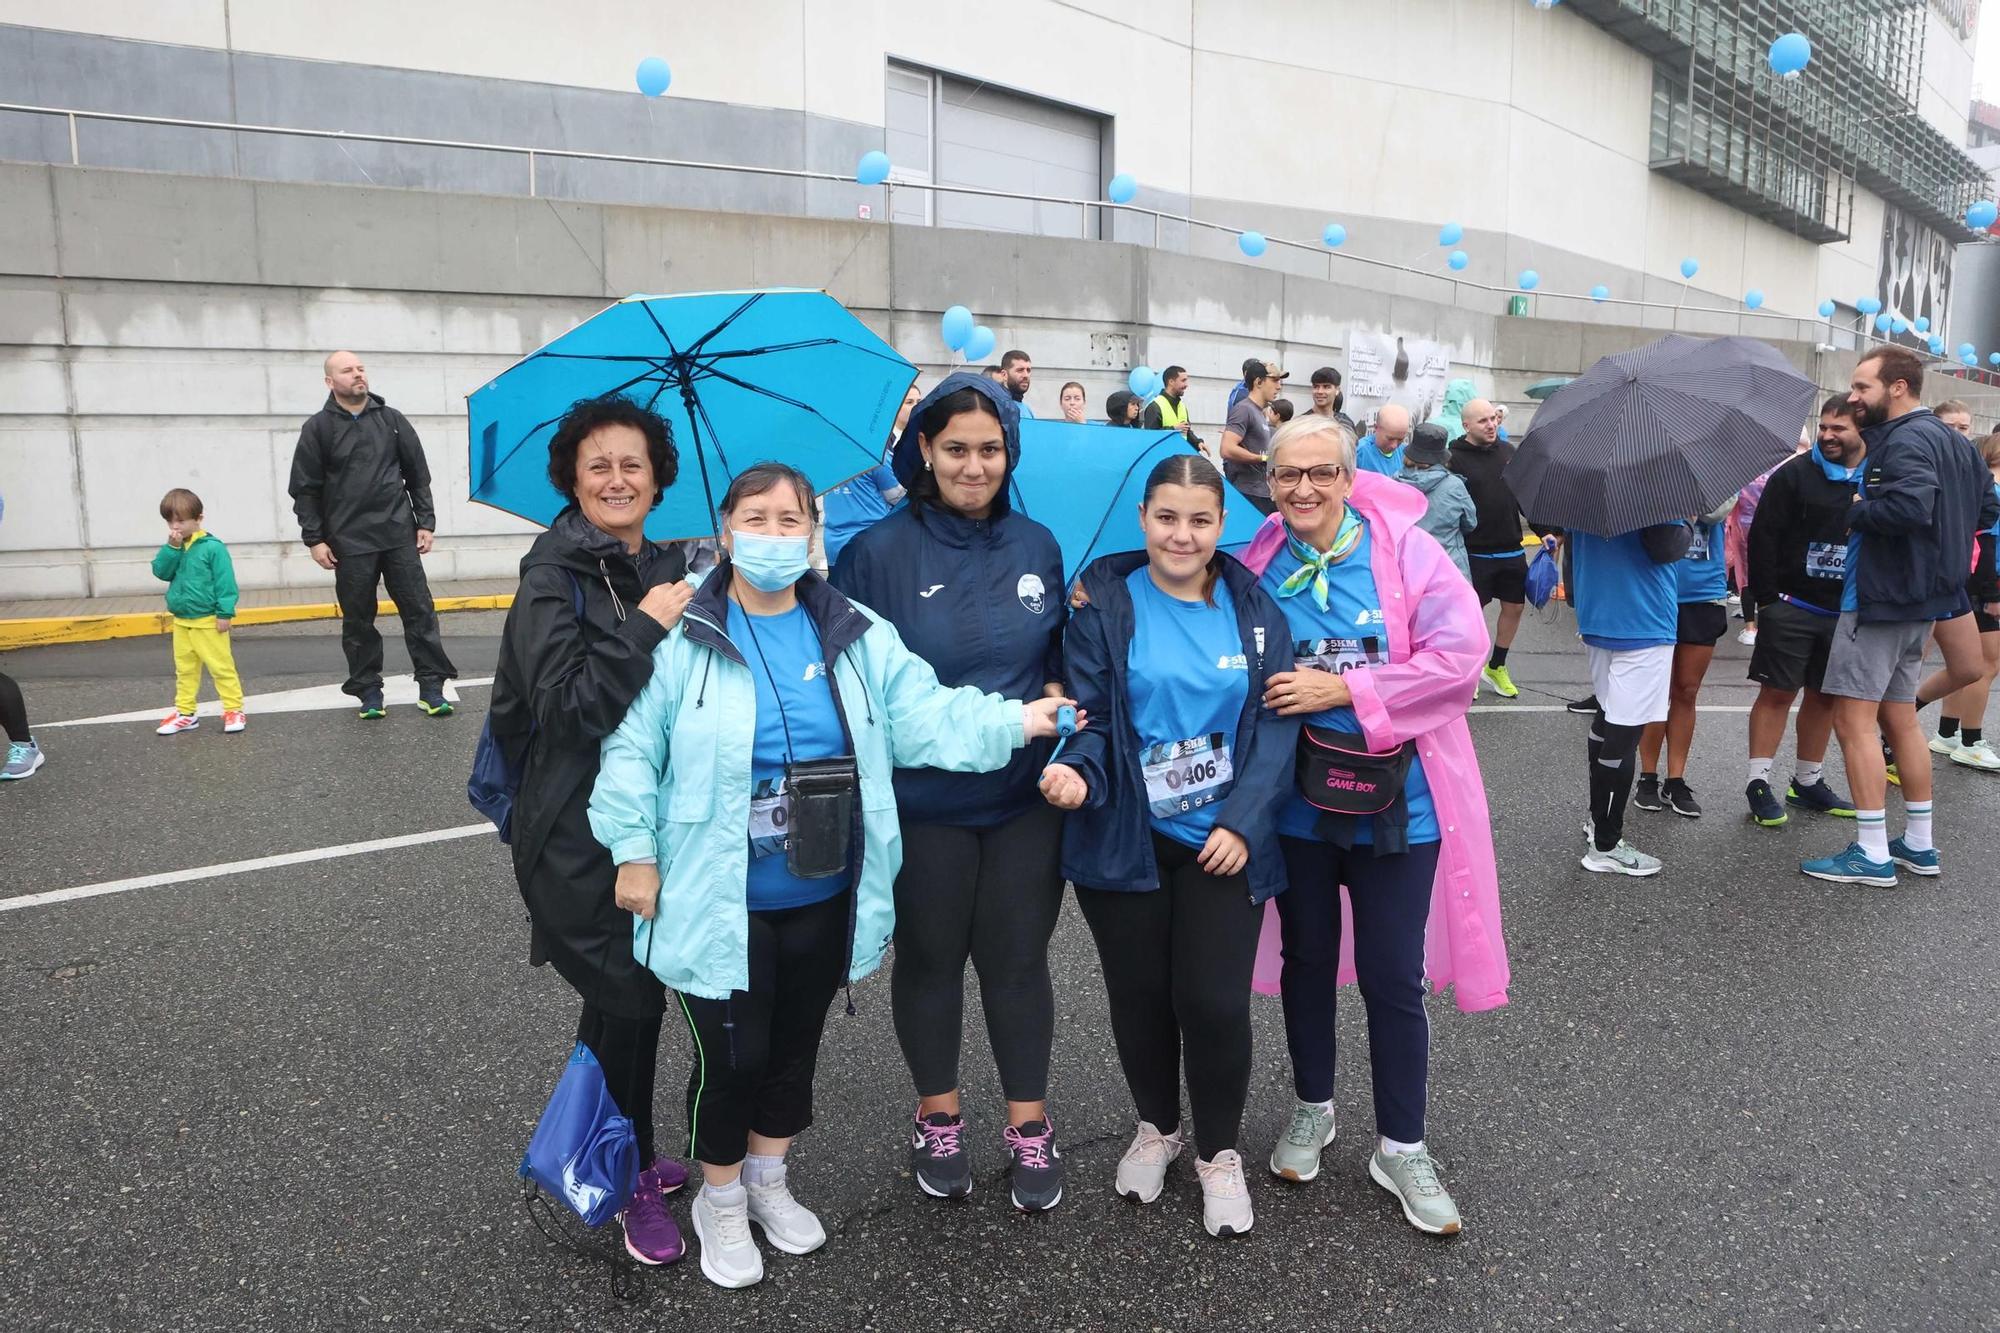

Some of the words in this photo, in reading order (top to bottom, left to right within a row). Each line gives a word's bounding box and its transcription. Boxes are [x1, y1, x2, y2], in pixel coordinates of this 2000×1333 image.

[1330, 639, 1358, 648] 5KM
[1165, 759, 1217, 790] 0406
[1326, 777, 1356, 791] GAME
[1355, 782, 1377, 793] BOY
